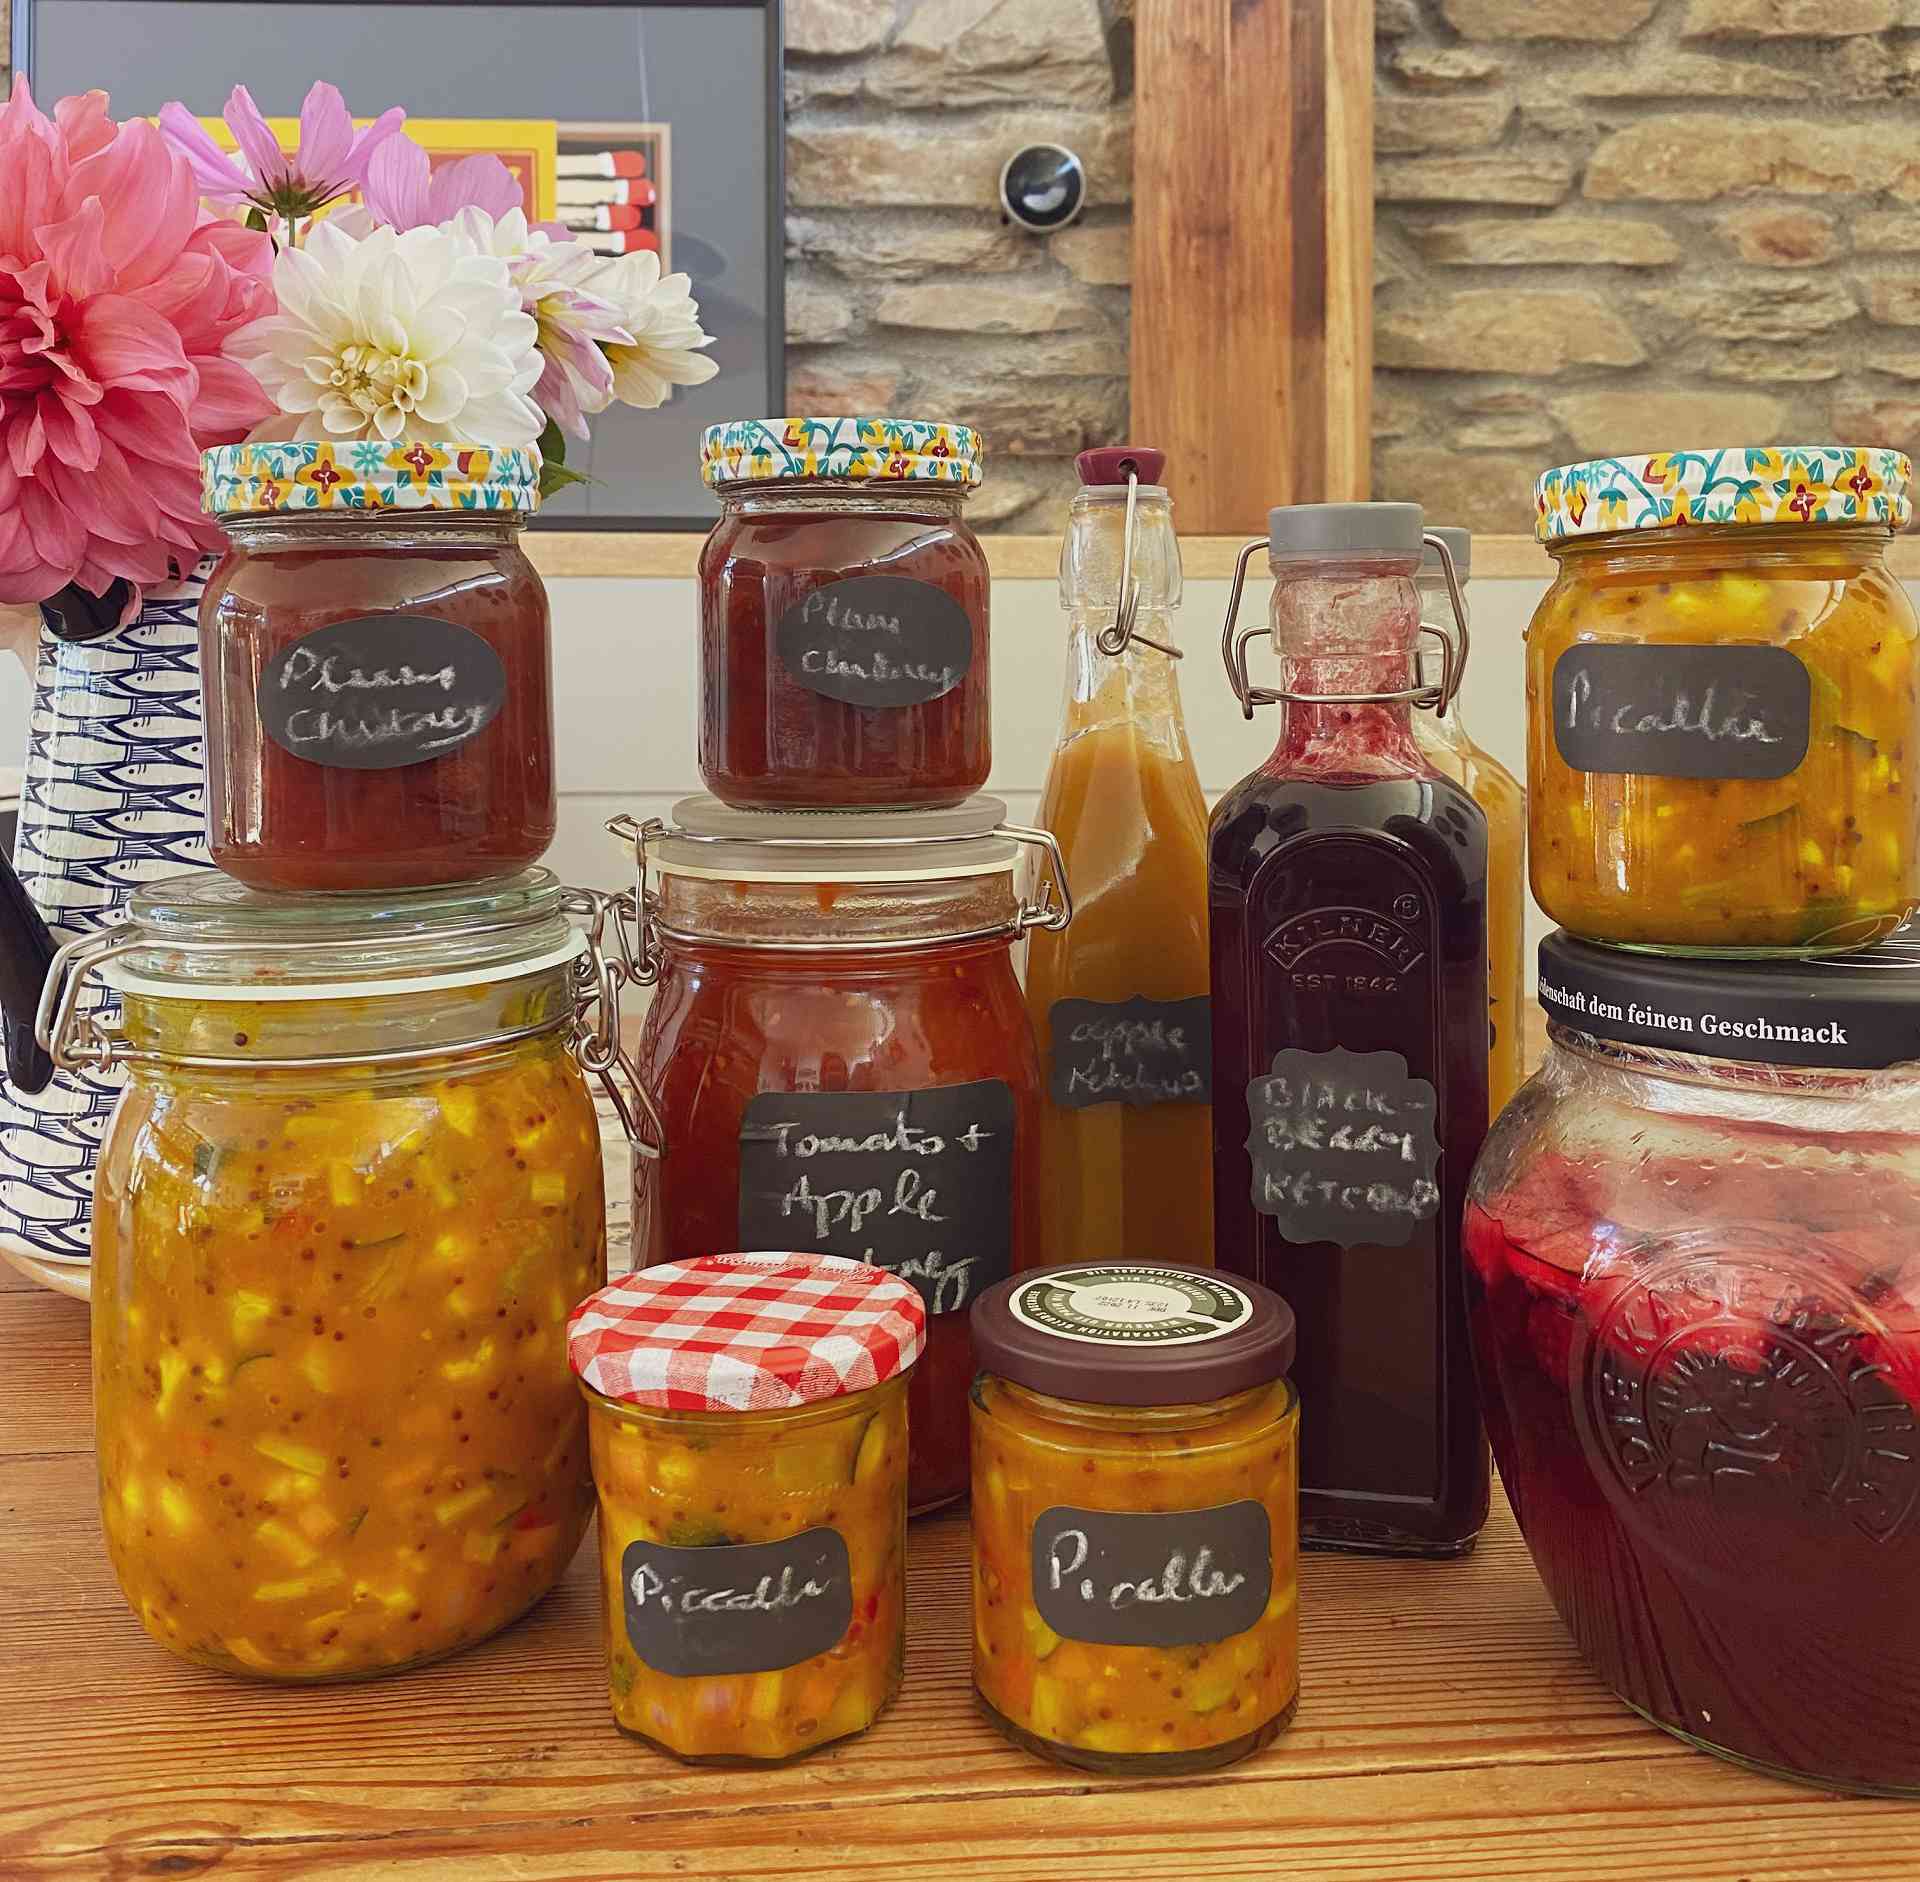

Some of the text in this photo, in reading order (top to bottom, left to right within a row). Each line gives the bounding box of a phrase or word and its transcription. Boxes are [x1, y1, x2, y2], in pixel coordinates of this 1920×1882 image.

[1274, 915, 1410, 960] KILNER
[1292, 973, 1337, 992] EST
[1589, 995, 1623, 1021] dem
[1627, 1003, 1694, 1032] feinen
[1700, 1013, 1848, 1045] Geschmack
[769, 1111, 947, 1158] Tomato
[781, 1168, 952, 1240] Apple
